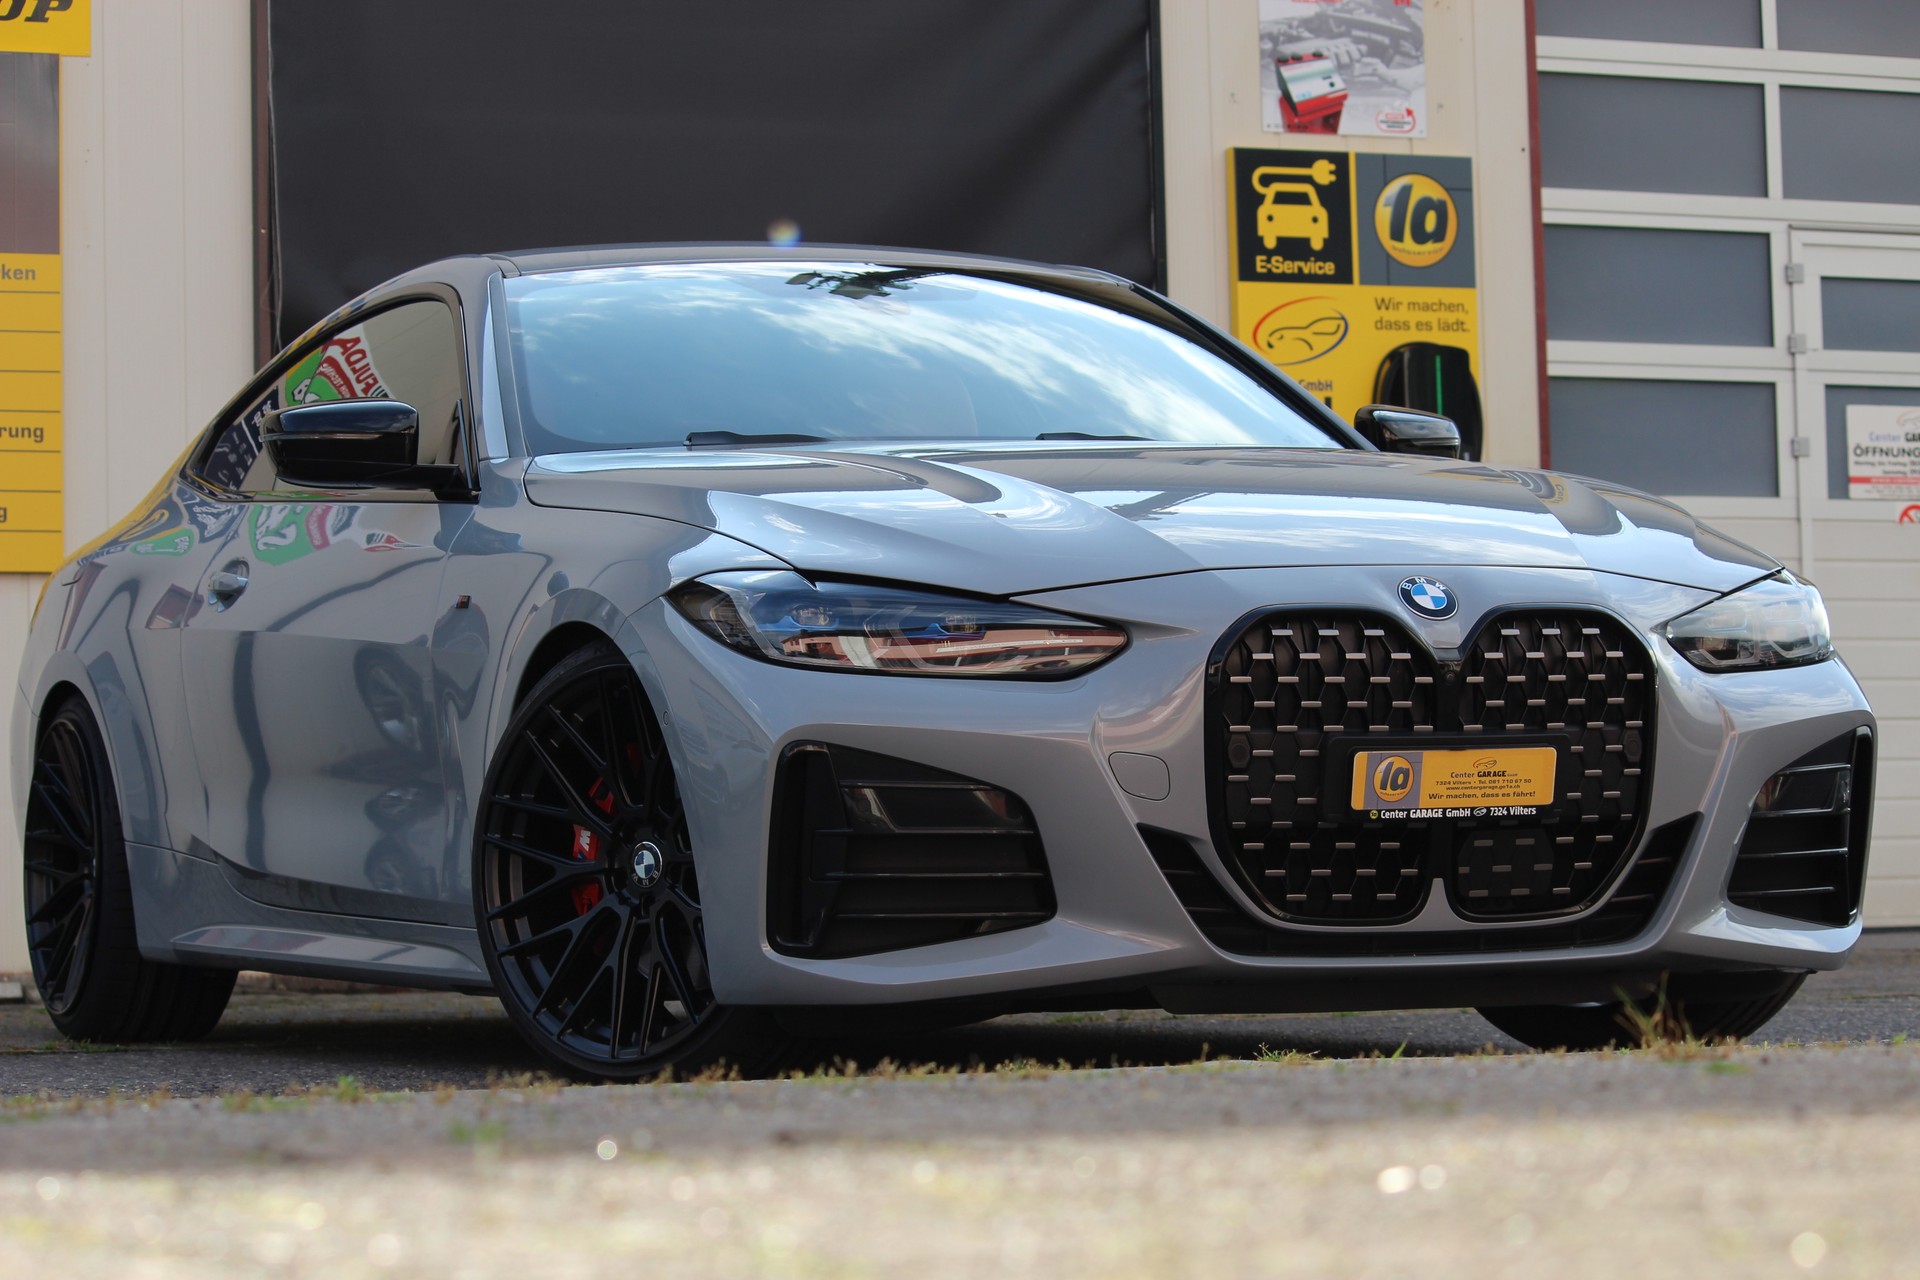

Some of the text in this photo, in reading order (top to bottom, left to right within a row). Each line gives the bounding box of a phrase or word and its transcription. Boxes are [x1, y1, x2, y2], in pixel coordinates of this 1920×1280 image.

[1383, 183, 1449, 246] 1a
[0, 263, 36, 281] ken
[1255, 255, 1336, 275] E-Service
[1374, 297, 1469, 315] Wir machen,
[1374, 316, 1471, 333] dass es lädt.
[1401, 576, 1447, 591] BMW
[1378, 760, 1411, 792] 1a
[1450, 771, 1475, 779] Center
[1477, 770, 1507, 778] GARAGE
[1480, 791, 1500, 799] dass
[1512, 790, 1536, 798] fährt!
[1380, 809, 1408, 819] Center
[1409, 808, 1443, 818] GARAGE
[1445, 808, 1471, 818] GmbH
[1489, 807, 1508, 816] 7324
[1509, 806, 1537, 816] Vilters
